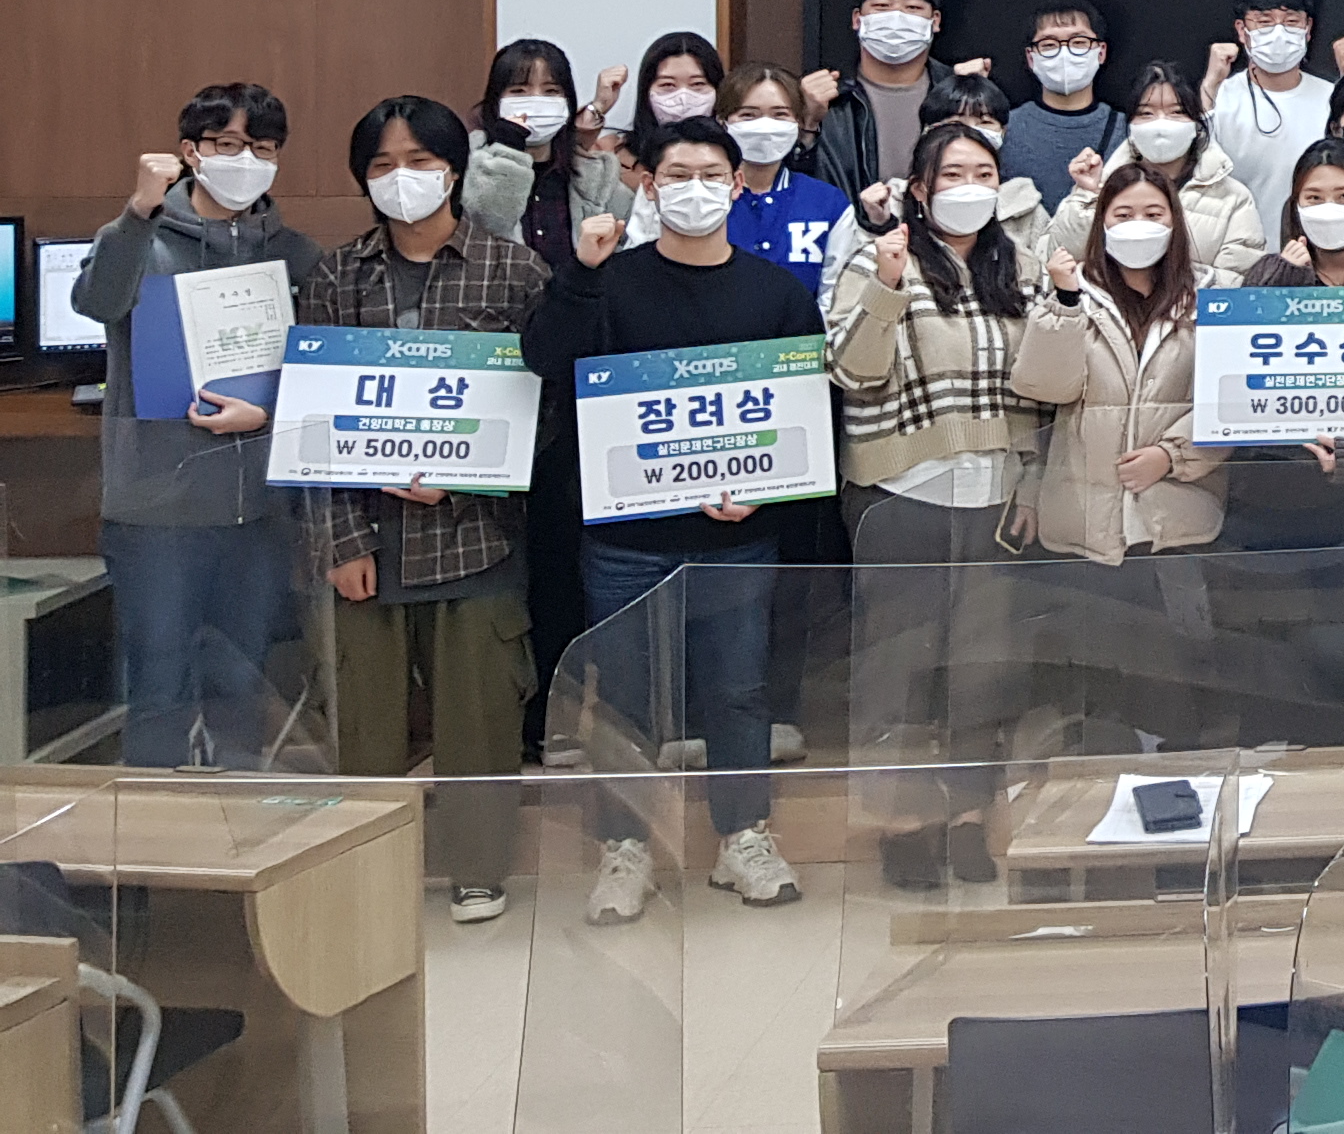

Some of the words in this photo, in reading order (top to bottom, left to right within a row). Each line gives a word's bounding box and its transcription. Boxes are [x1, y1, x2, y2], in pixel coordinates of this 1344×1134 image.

[787, 220, 829, 264] K
[494, 346, 521, 357] X-Co
[637, 386, 775, 435] 장려상
[358, 417, 416, 431] 건양대학교
[419, 418, 456, 432] 총장상
[364, 438, 471, 461] 500,000
[657, 432, 758, 457] 실전문제연구단장상
[671, 452, 774, 484] 200,000
